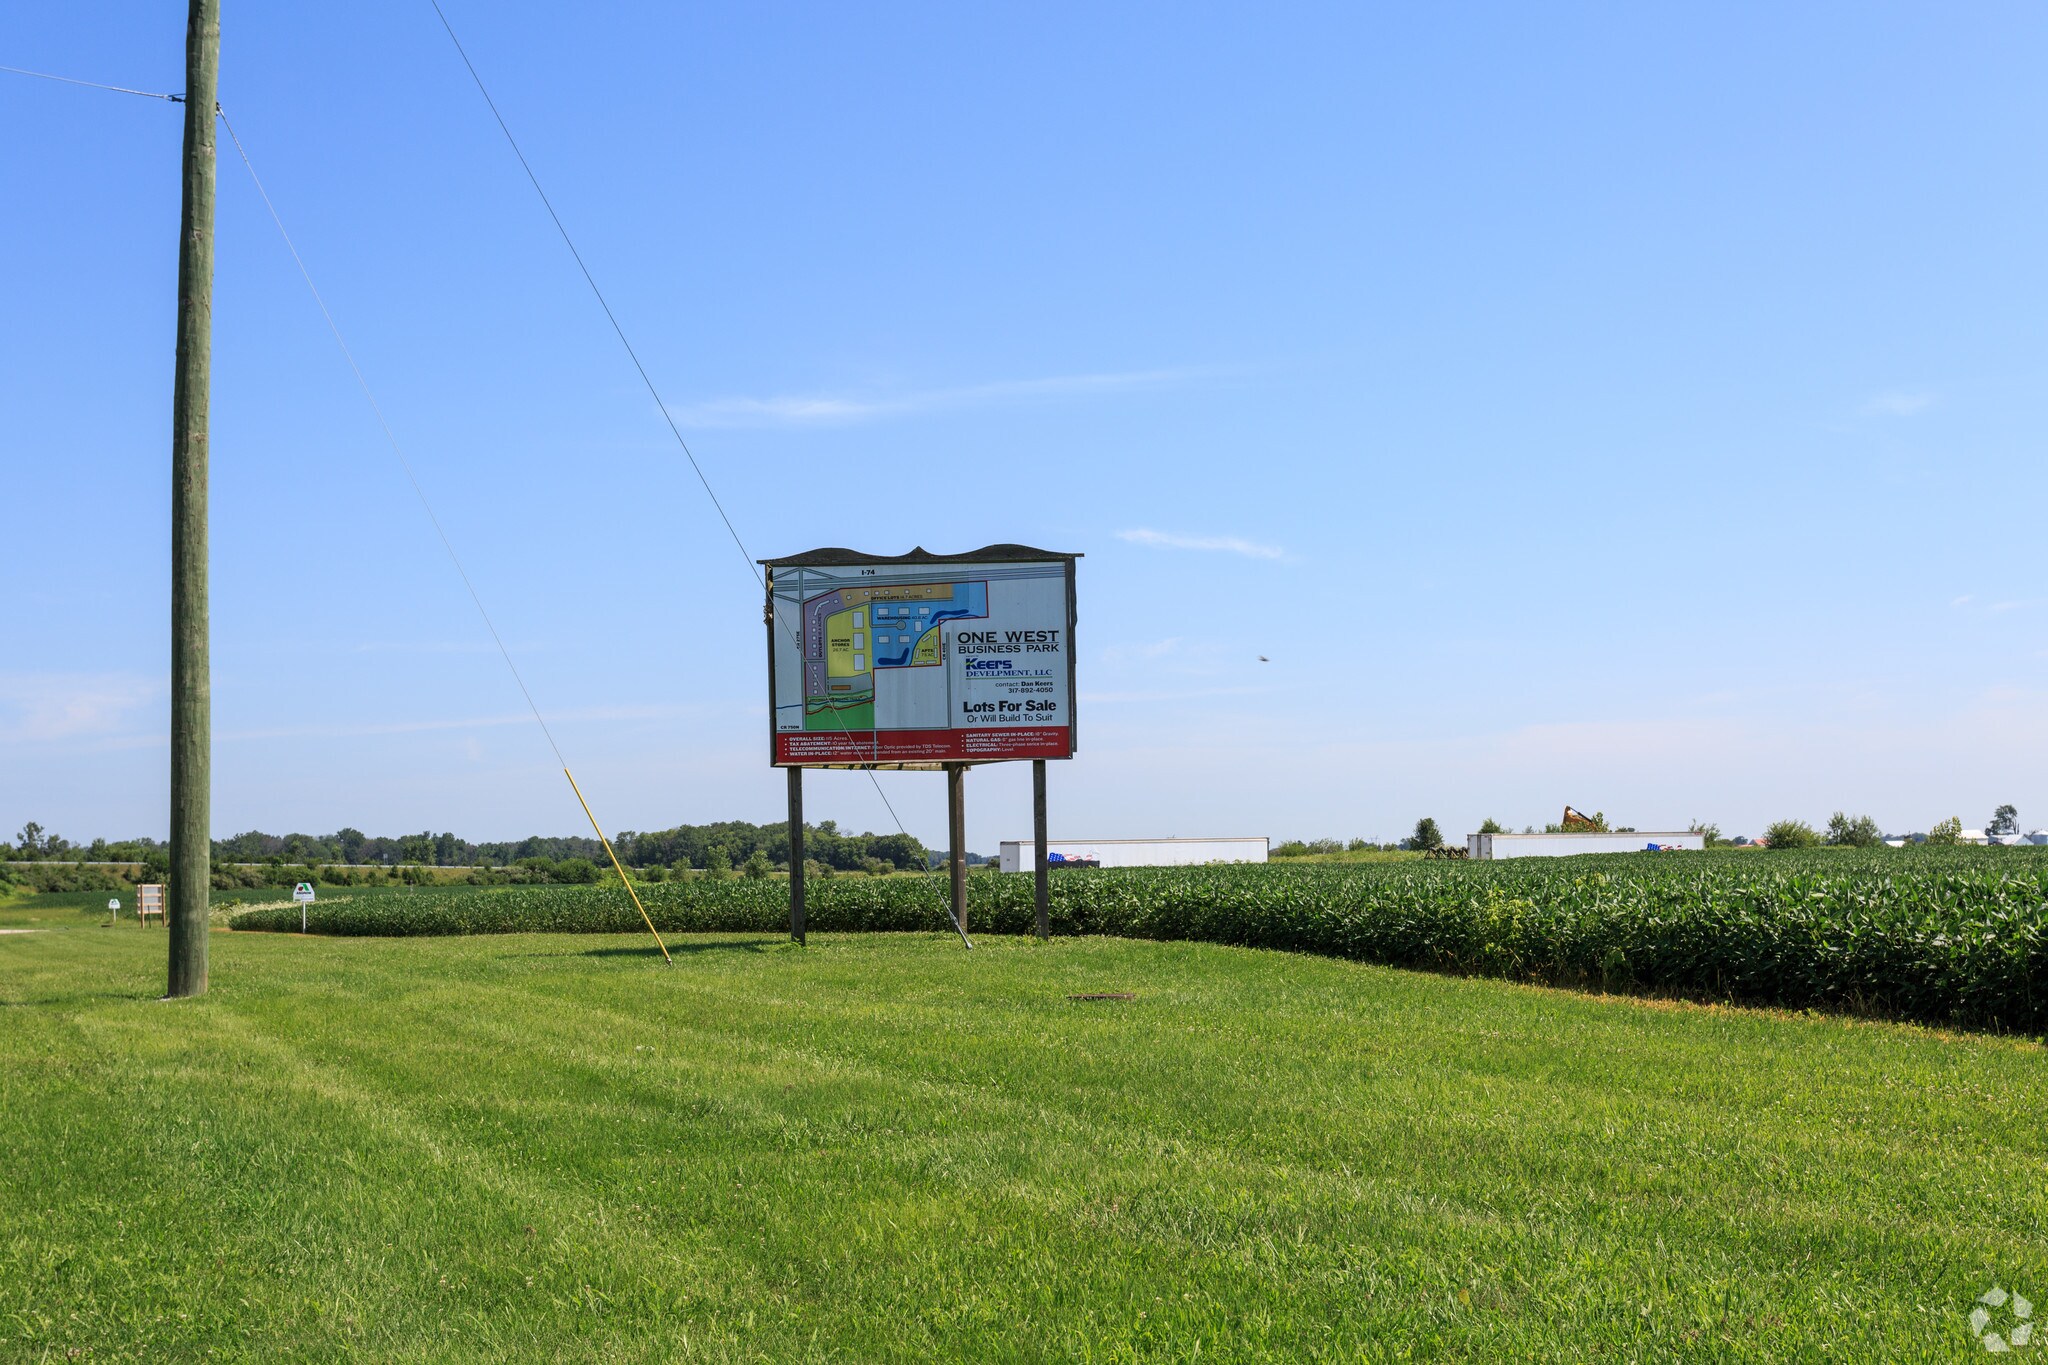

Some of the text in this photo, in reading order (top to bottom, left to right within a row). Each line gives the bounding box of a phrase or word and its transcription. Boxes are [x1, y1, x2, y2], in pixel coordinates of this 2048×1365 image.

[958, 630, 1059, 644] ONE WEST
[958, 644, 1059, 654] BUSINESS PARK
[966, 658, 1012, 670] Keers
[963, 700, 1056, 713] Lots For Sale
